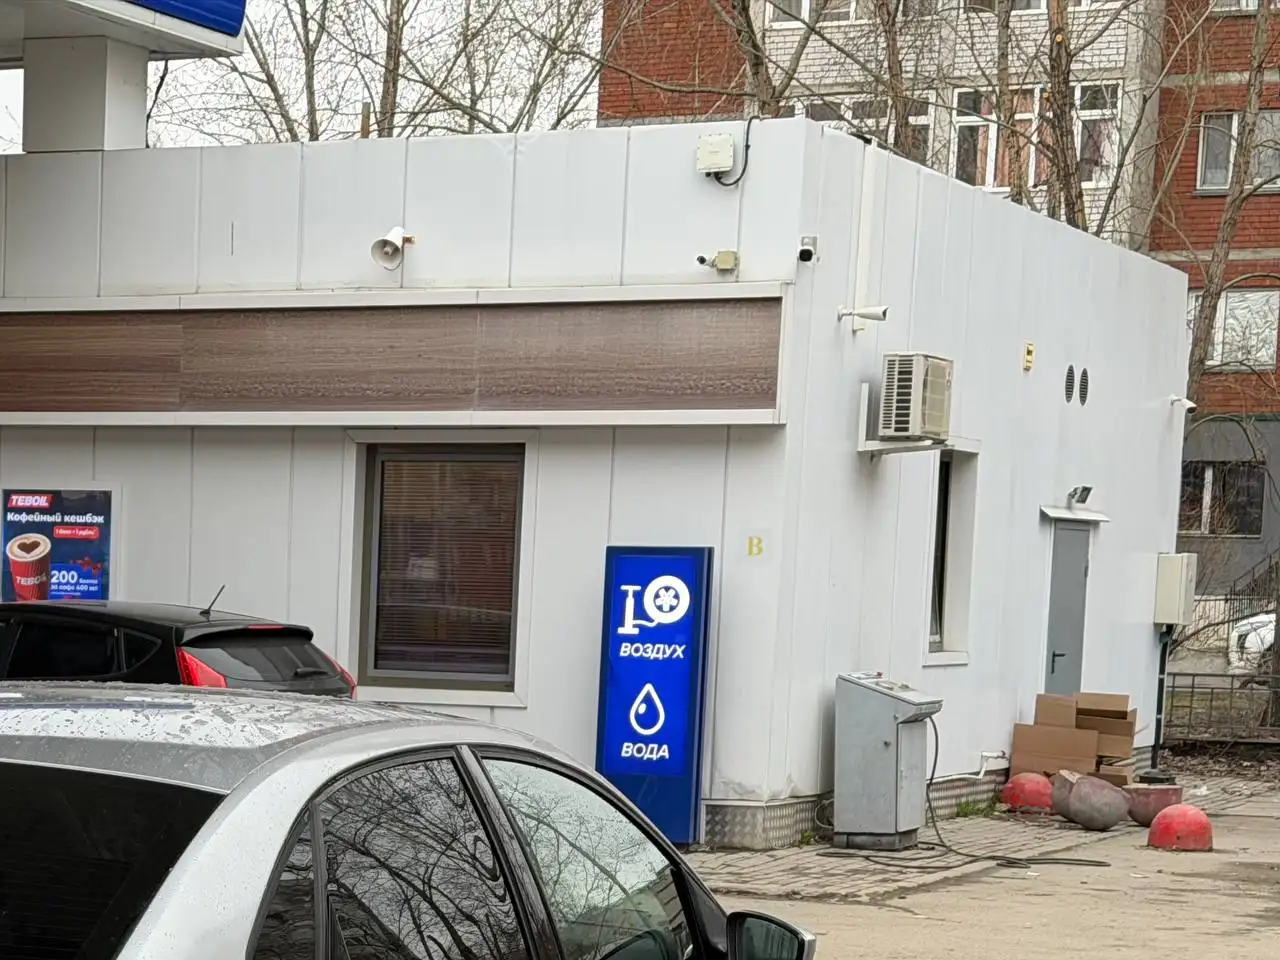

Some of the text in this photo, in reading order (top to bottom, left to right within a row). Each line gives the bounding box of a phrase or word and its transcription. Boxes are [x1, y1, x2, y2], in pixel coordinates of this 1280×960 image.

[10, 495, 49, 507] TEBOIL
[7, 512, 104, 523] Кофейный кешбэк
[747, 536, 764, 556] В
[50, 571, 77, 583] 200
[620, 642, 687, 660] ВОЗДУХ
[621, 742, 670, 760] ВОДА
